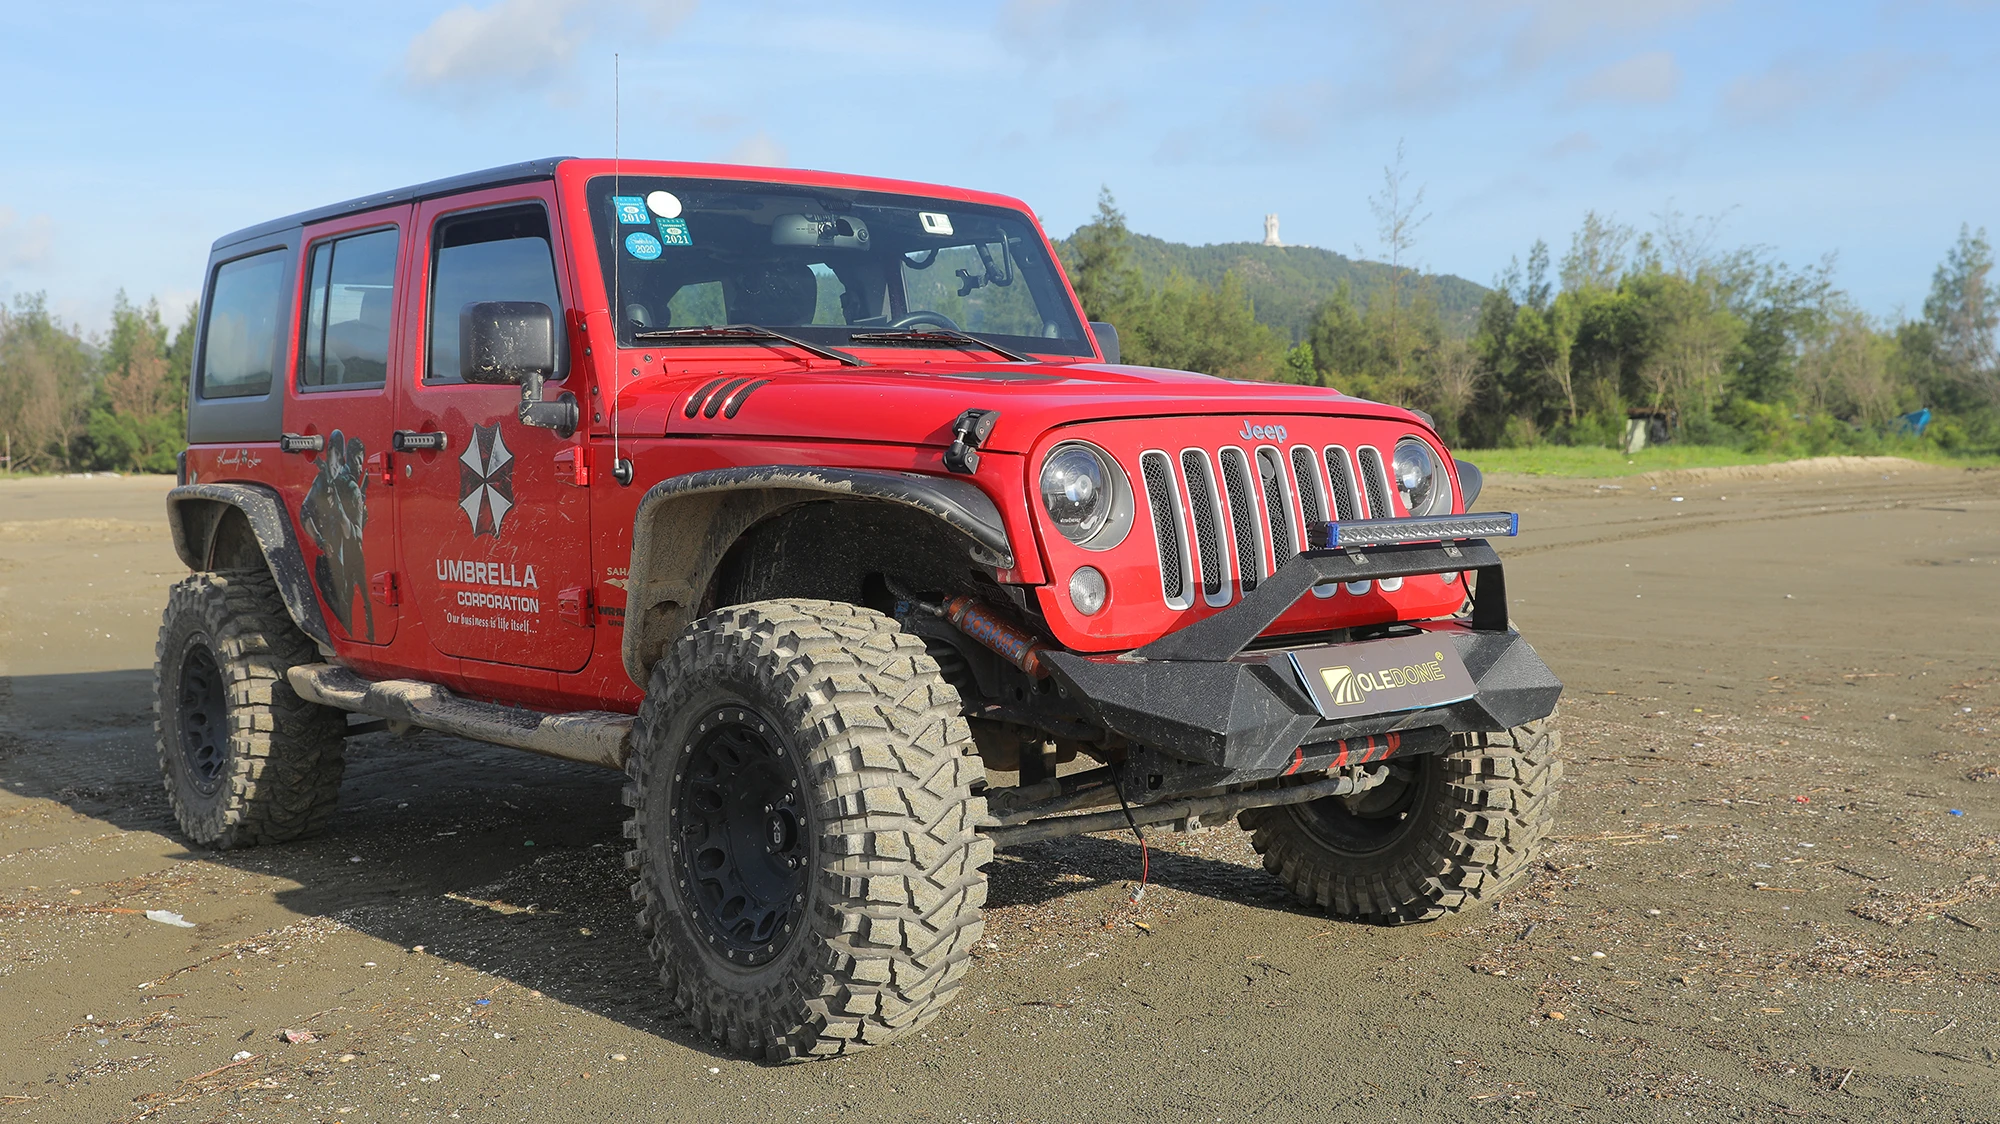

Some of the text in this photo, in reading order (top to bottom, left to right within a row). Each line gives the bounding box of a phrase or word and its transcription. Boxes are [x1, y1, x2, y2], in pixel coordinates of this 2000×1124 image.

[621, 213, 646, 222] 2019
[635, 244, 656, 254] 2020
[664, 235, 689, 244] 2021
[1239, 419, 1288, 444] Jeep
[436, 559, 538, 588] UMBRELLA
[457, 591, 539, 613] CORPORATION
[461, 613, 489, 627] business
[490, 616, 497, 629] is
[497, 616, 509, 632] life
